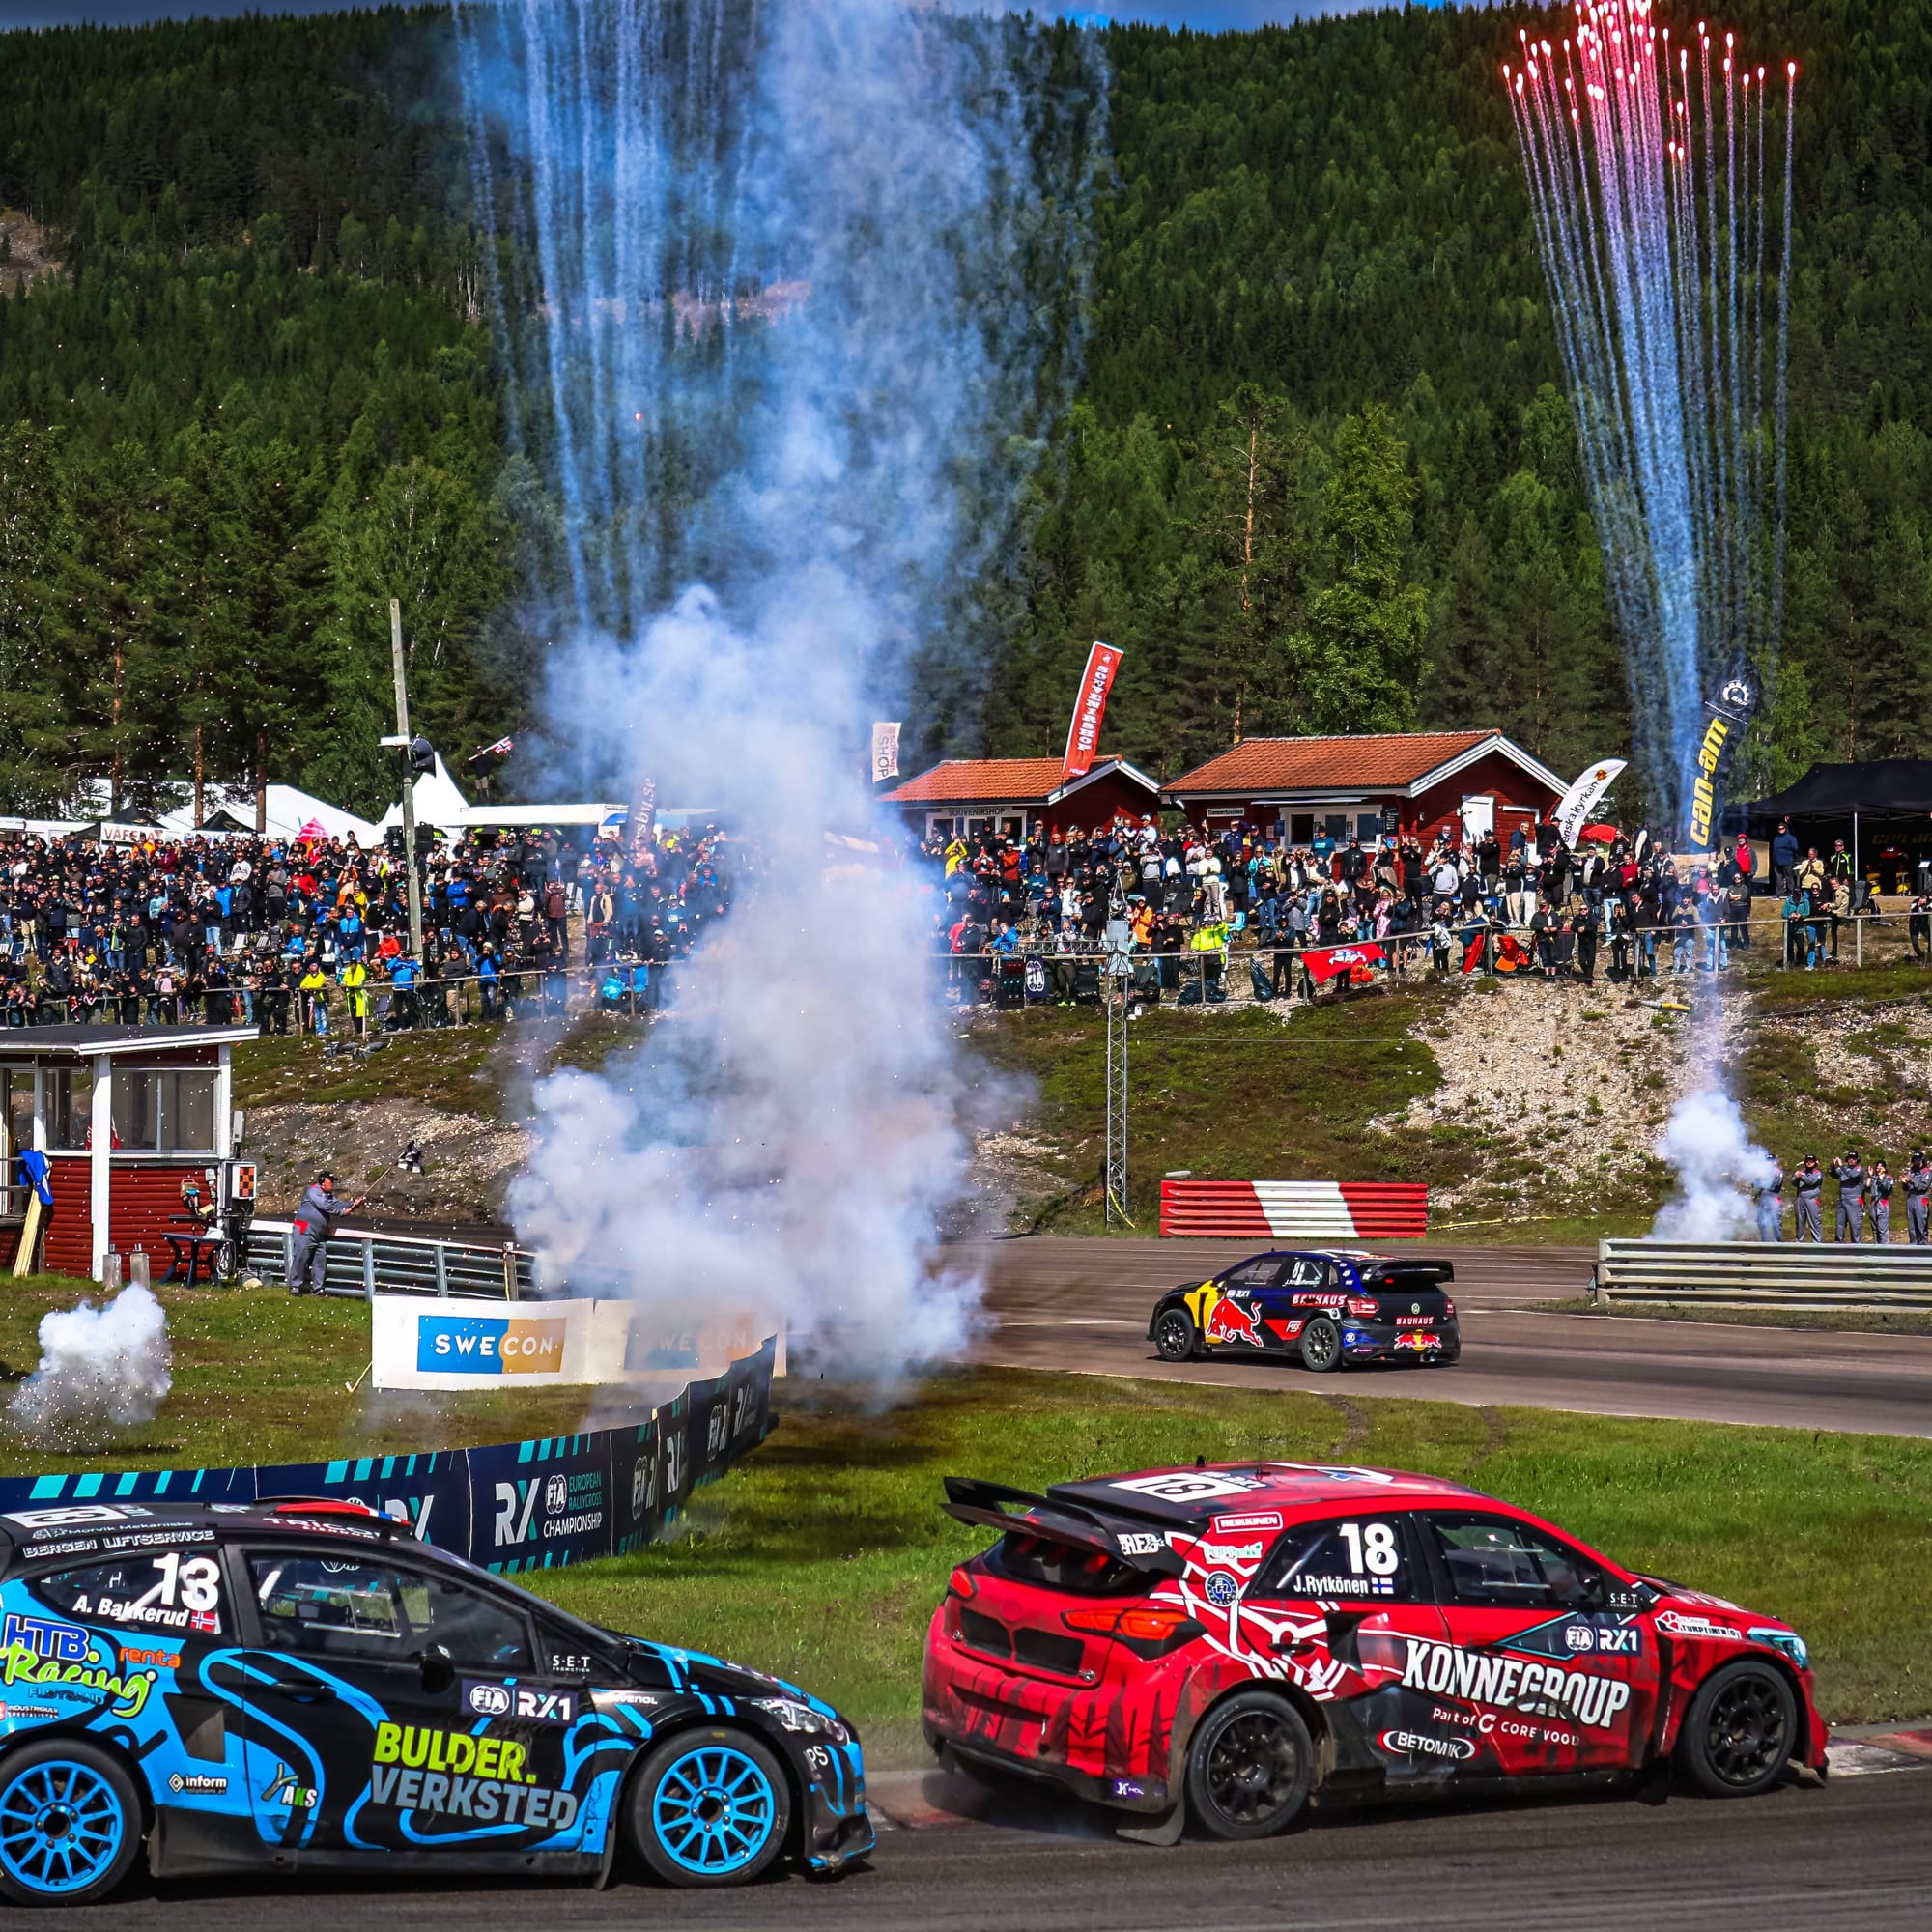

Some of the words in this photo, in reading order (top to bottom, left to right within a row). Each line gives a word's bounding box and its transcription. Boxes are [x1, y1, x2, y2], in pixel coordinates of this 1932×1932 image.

[1396, 1317, 1435, 1325] BAUHAUS
[569, 1472, 602, 1493] EUROPEAN
[495, 1478, 541, 1546] RX
[568, 1492, 603, 1511] RALLYCROSS
[543, 1512, 603, 1538] CHAMPIONSHIP
[23, 1539, 98, 1558] BERGEN
[102, 1529, 215, 1549] LIFTSERVICE
[1339, 1523, 1399, 1576] 18
[153, 1552, 221, 1612] 13
[1293, 1575, 1369, 1596] J.Rytkönen
[71, 1595, 93, 1613] A.
[98, 1597, 189, 1627] Bakkerud
[1566, 1628, 1594, 1647] FIA
[1600, 1628, 1637, 1651] RX1
[119, 1646, 182, 1669] renta
[0, 1641, 154, 1718] Racing
[1402, 1639, 1631, 1728] KONNEGROUP
[471, 1690, 507, 1711] FIA
[517, 1691, 571, 1721] RX1
[1462, 1713, 1476, 1726] of
[374, 1721, 537, 1784] BULDER.
[1397, 1732, 1463, 1759] BETOMIK
[185, 1775, 227, 1787] inform
[372, 1765, 578, 1830] VERKSTED
